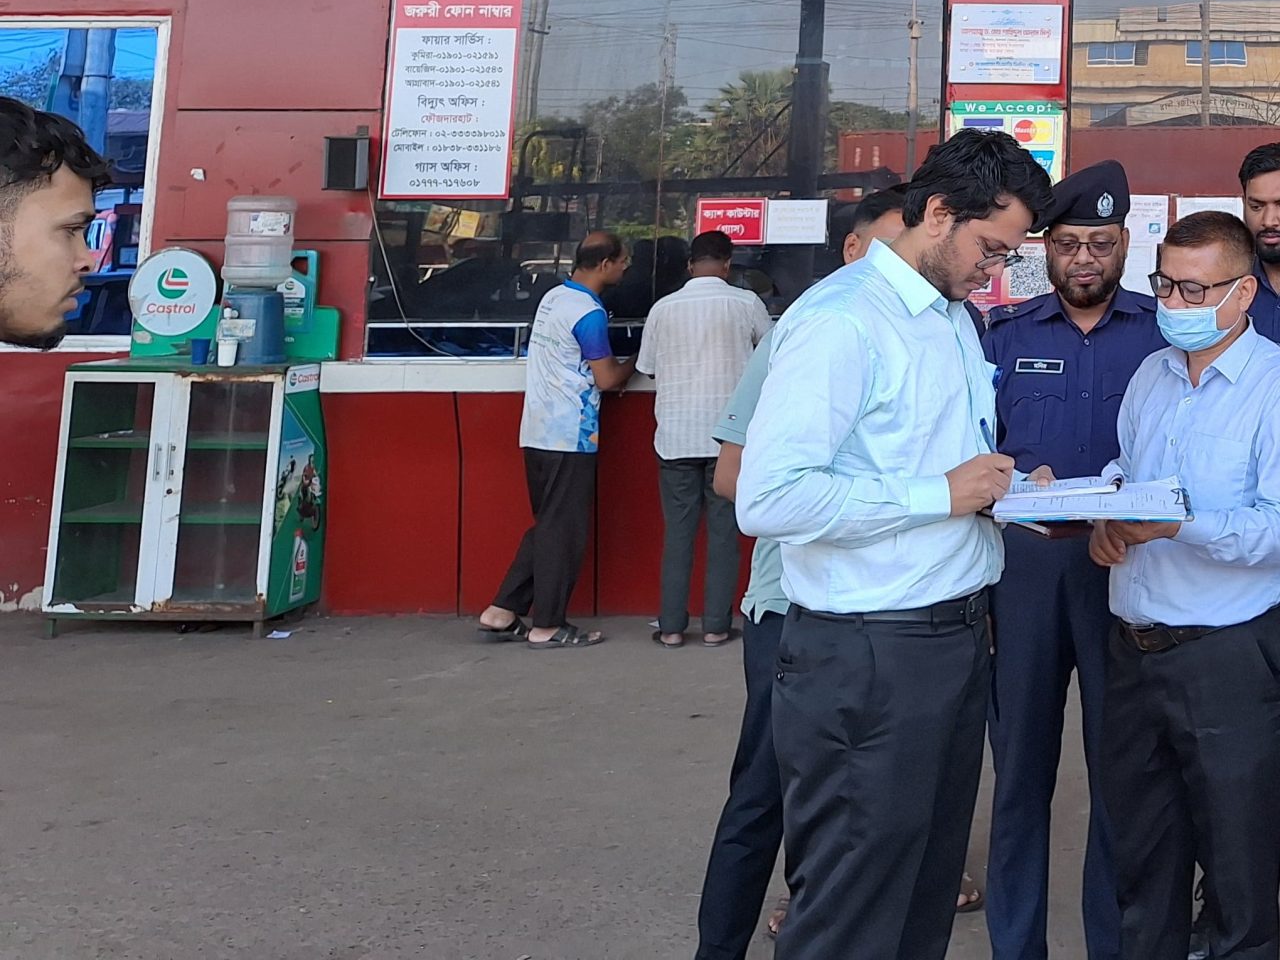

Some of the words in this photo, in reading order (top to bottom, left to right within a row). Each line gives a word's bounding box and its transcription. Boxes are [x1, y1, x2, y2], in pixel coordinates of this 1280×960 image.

[444, 5, 476, 18] ফোন
[448, 94, 478, 108] অফিস
[964, 103, 987, 113] We
[994, 102, 1052, 116] Accept
[415, 162, 438, 172] গ্যাস
[440, 159, 471, 172] অফিস
[146, 303, 196, 314] Castrol
